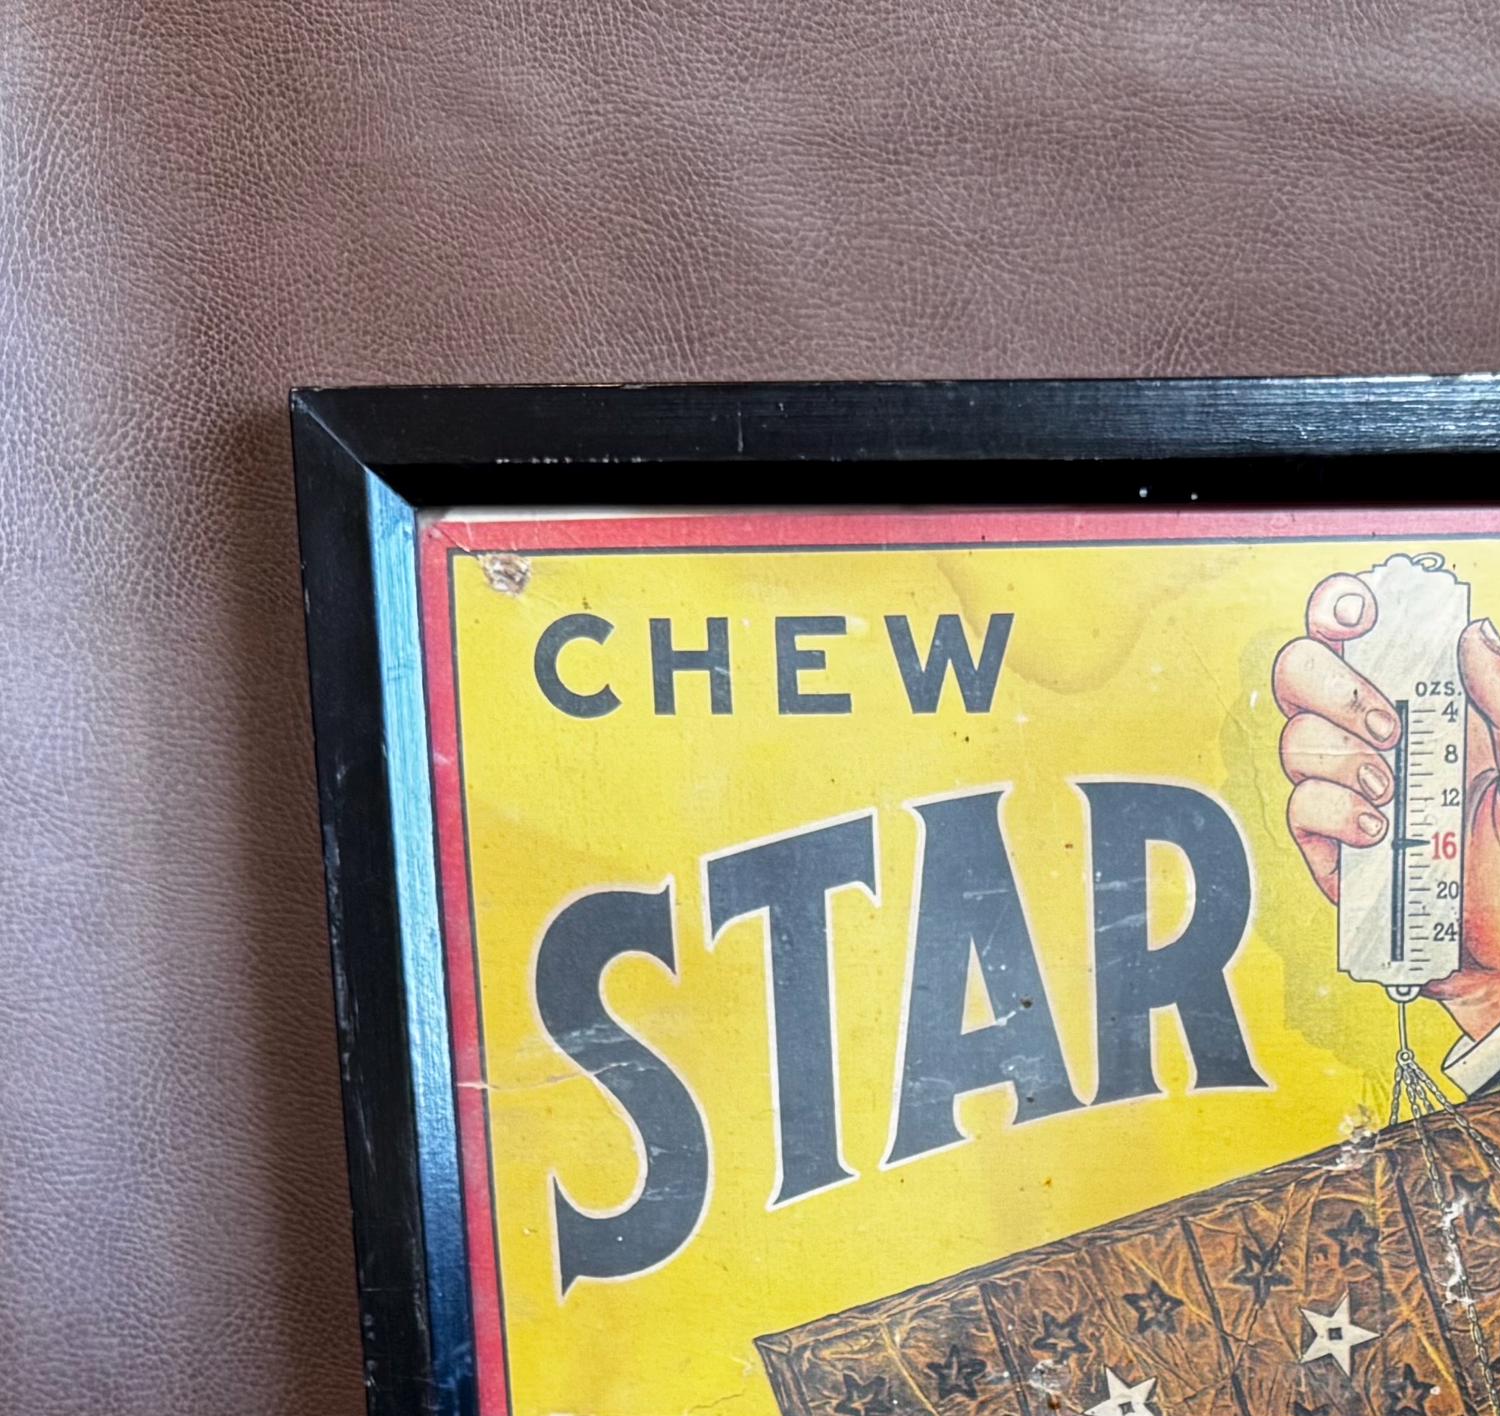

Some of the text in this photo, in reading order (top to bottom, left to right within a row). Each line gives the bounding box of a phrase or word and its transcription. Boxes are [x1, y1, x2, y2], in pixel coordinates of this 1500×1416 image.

[533, 612, 1015, 719] CHEW
[1441, 700, 1459, 723] 4
[1444, 743, 1459, 765] 8
[1440, 787, 1461, 807] 12
[1431, 831, 1458, 861] 16
[1435, 880, 1461, 900] 20
[1432, 921, 1458, 943] 24
[534, 778, 1273, 1299] STAR
